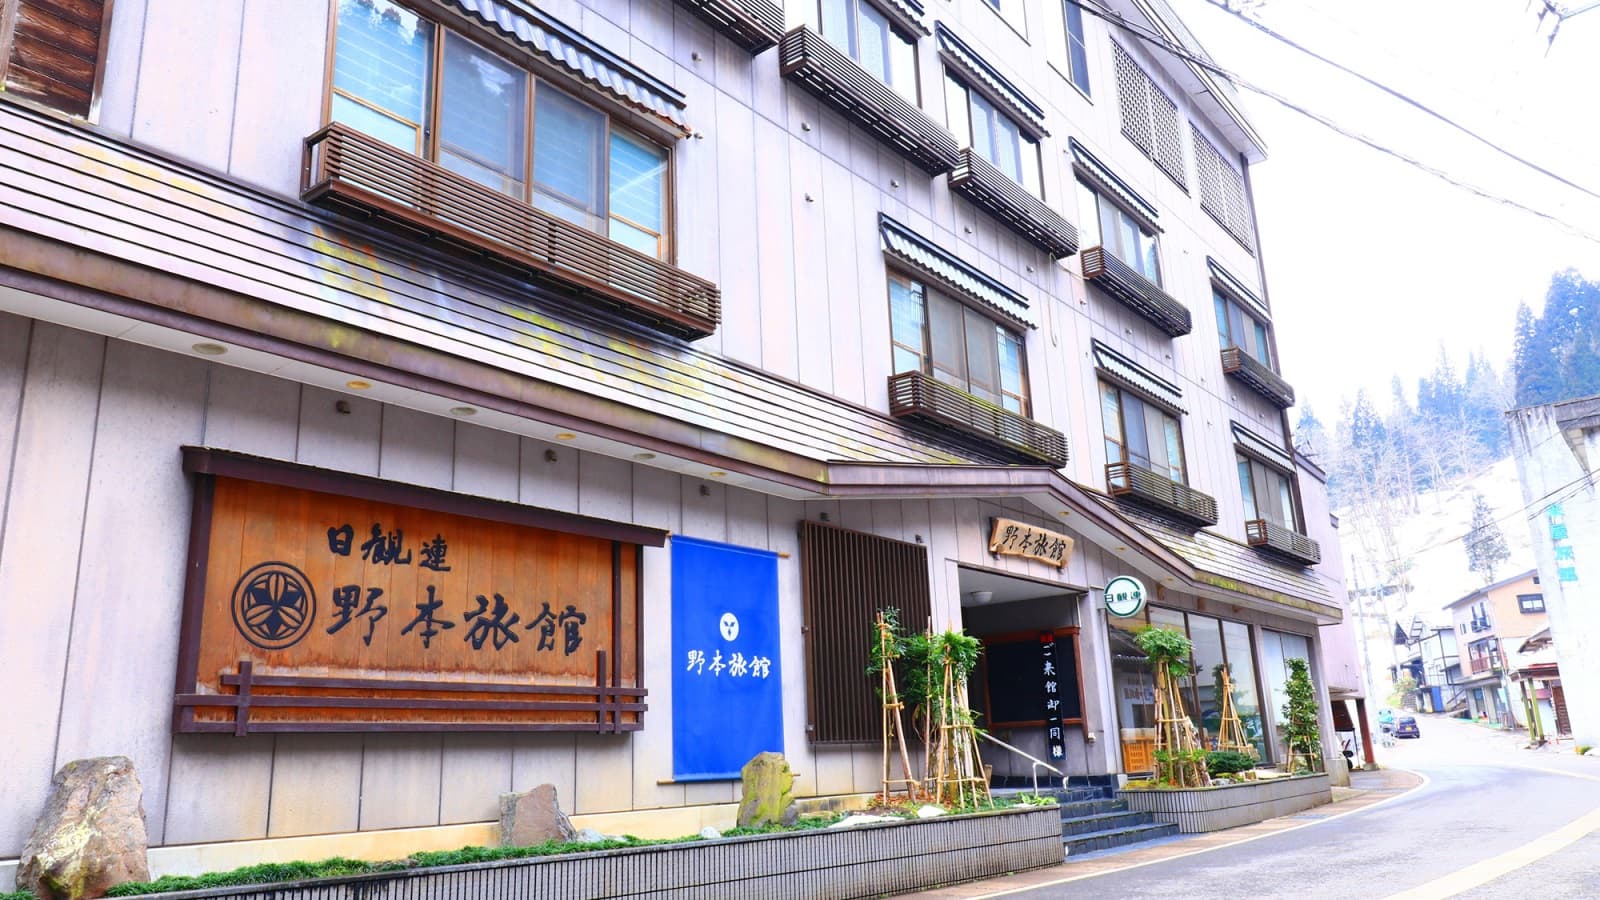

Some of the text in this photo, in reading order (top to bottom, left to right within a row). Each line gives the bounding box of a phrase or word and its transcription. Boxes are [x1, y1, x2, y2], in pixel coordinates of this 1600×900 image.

[1002, 525, 1066, 561] 野本旅館
[326, 585, 587, 656] 野本旅館
[686, 649, 771, 680] 野本旅館
